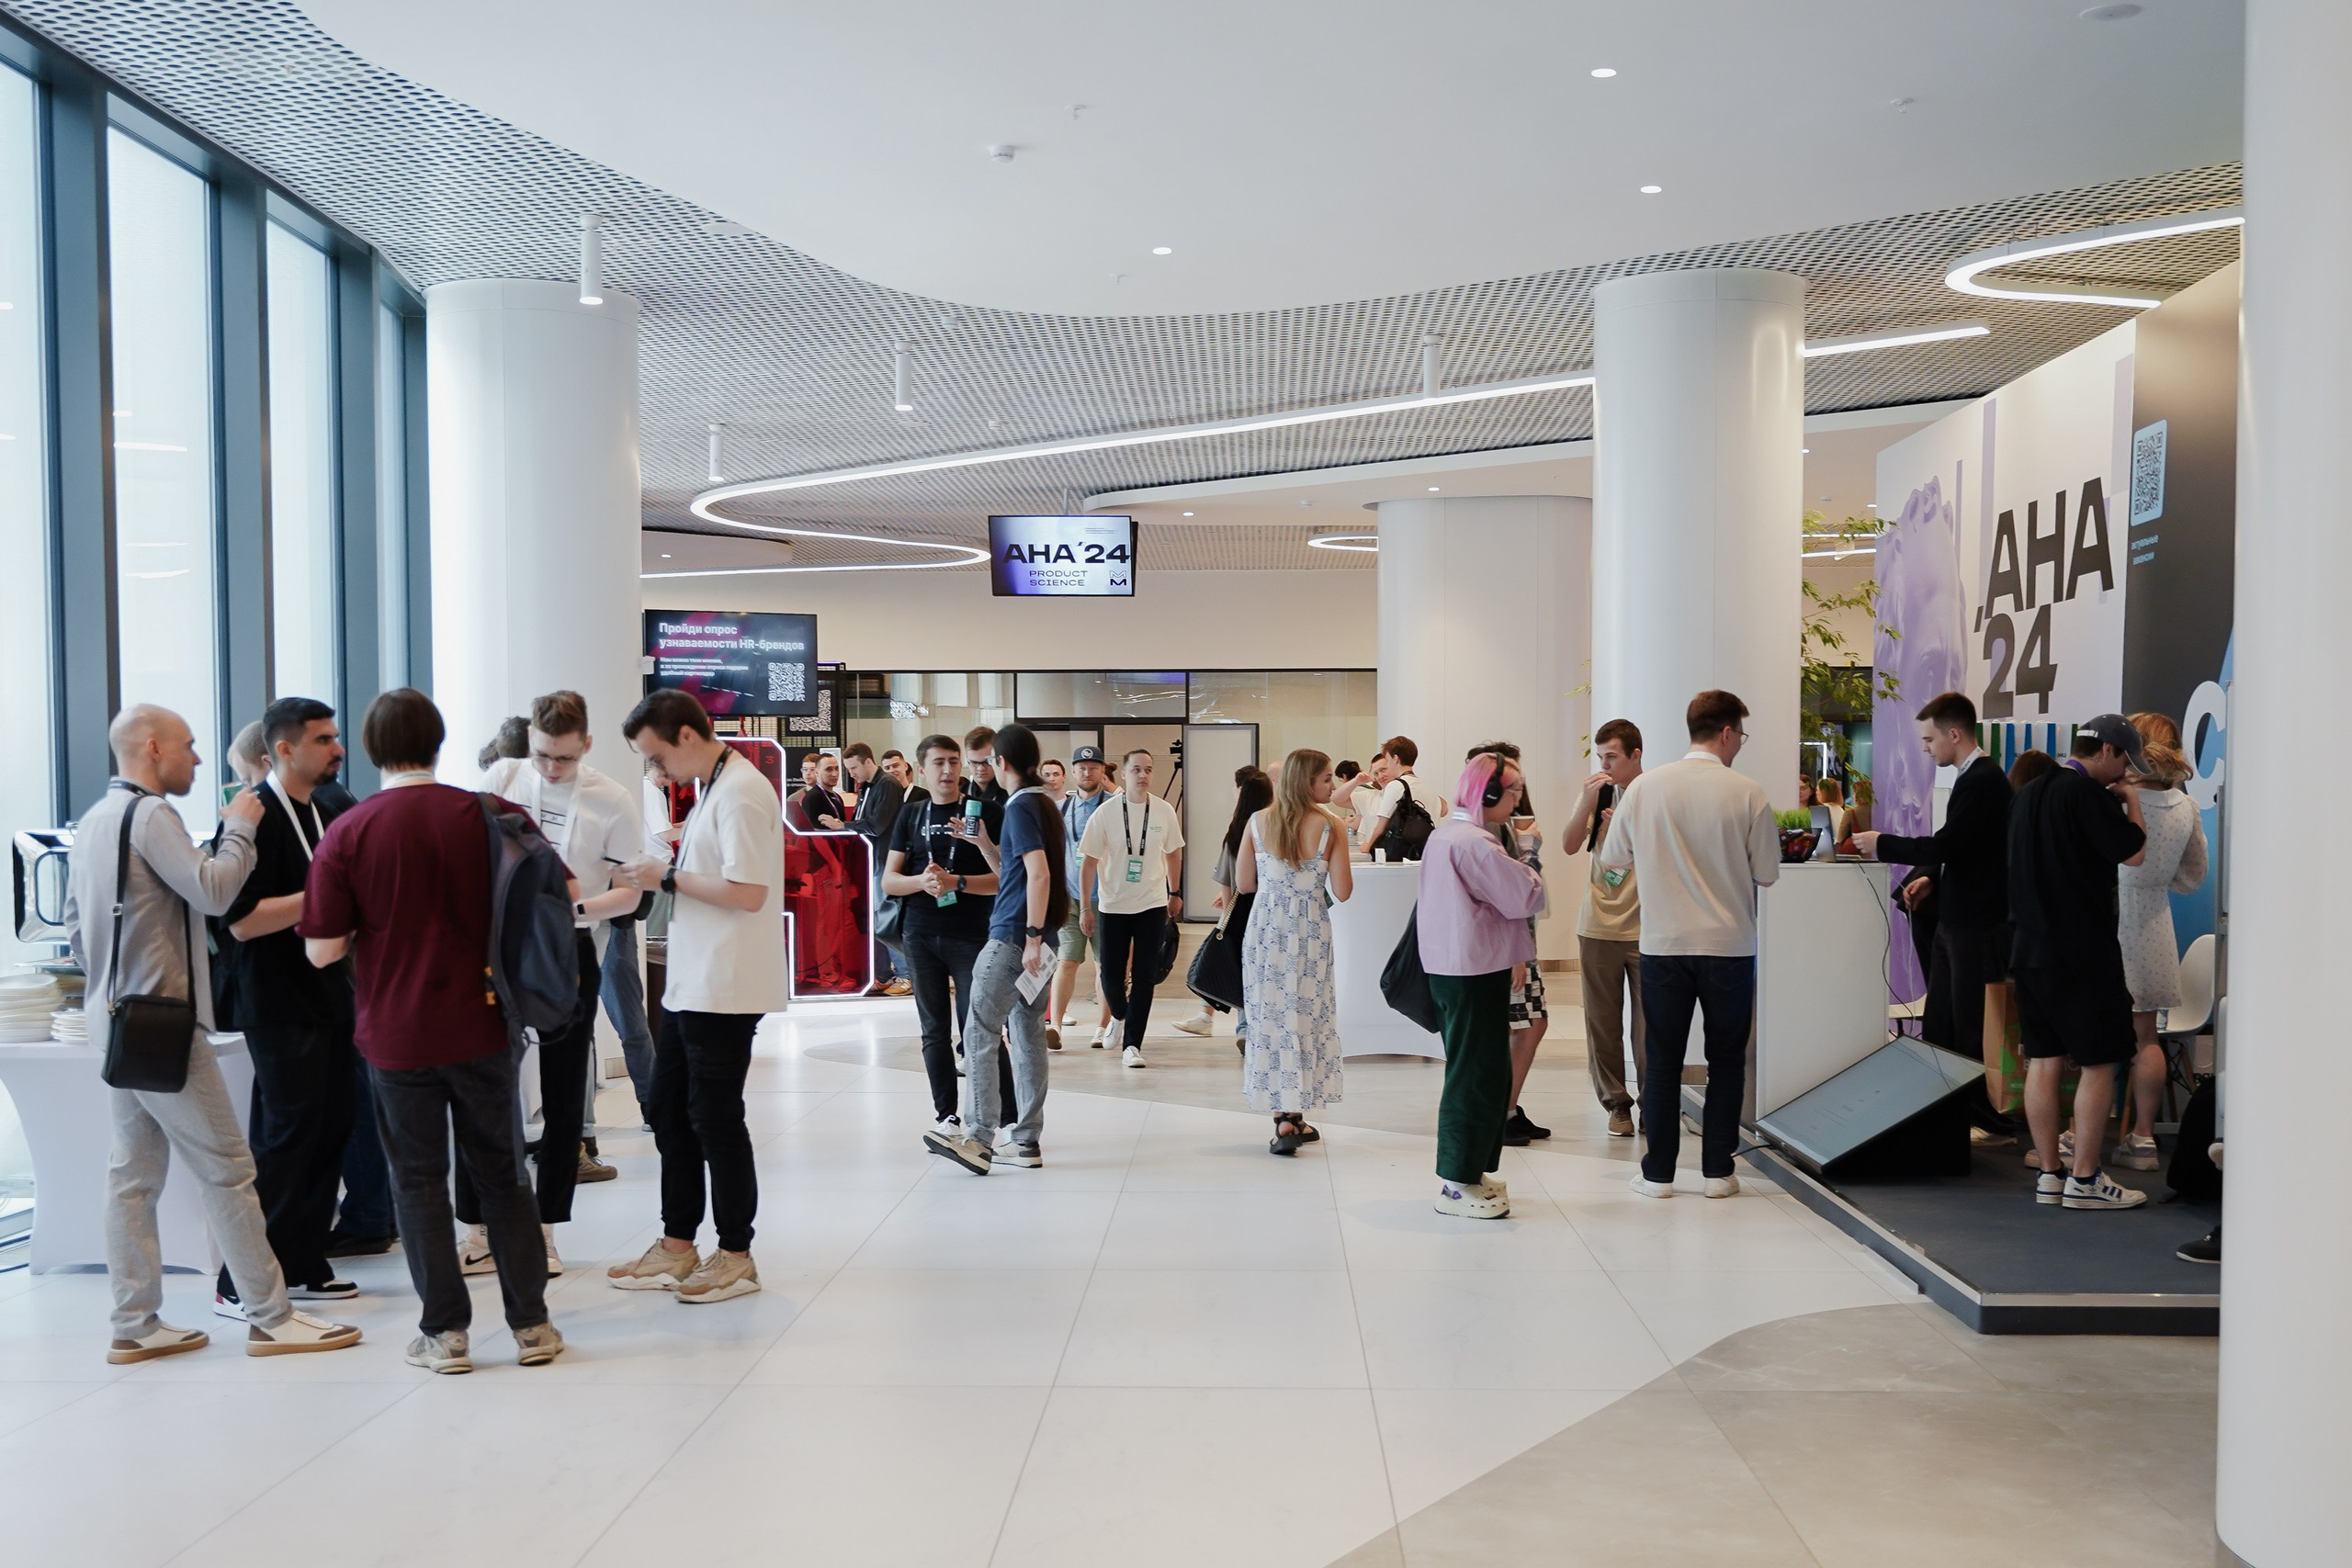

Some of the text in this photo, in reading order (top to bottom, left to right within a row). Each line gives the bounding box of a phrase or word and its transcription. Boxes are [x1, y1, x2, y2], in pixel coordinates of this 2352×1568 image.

[1984, 477, 2114, 620] AHA
[1029, 570, 1089, 578] PRODUCT
[1029, 579, 1085, 587] SCIENCE
[659, 622, 738, 636] Пройди опрос
[659, 638, 805, 651] узнаваемости HR-брендов
